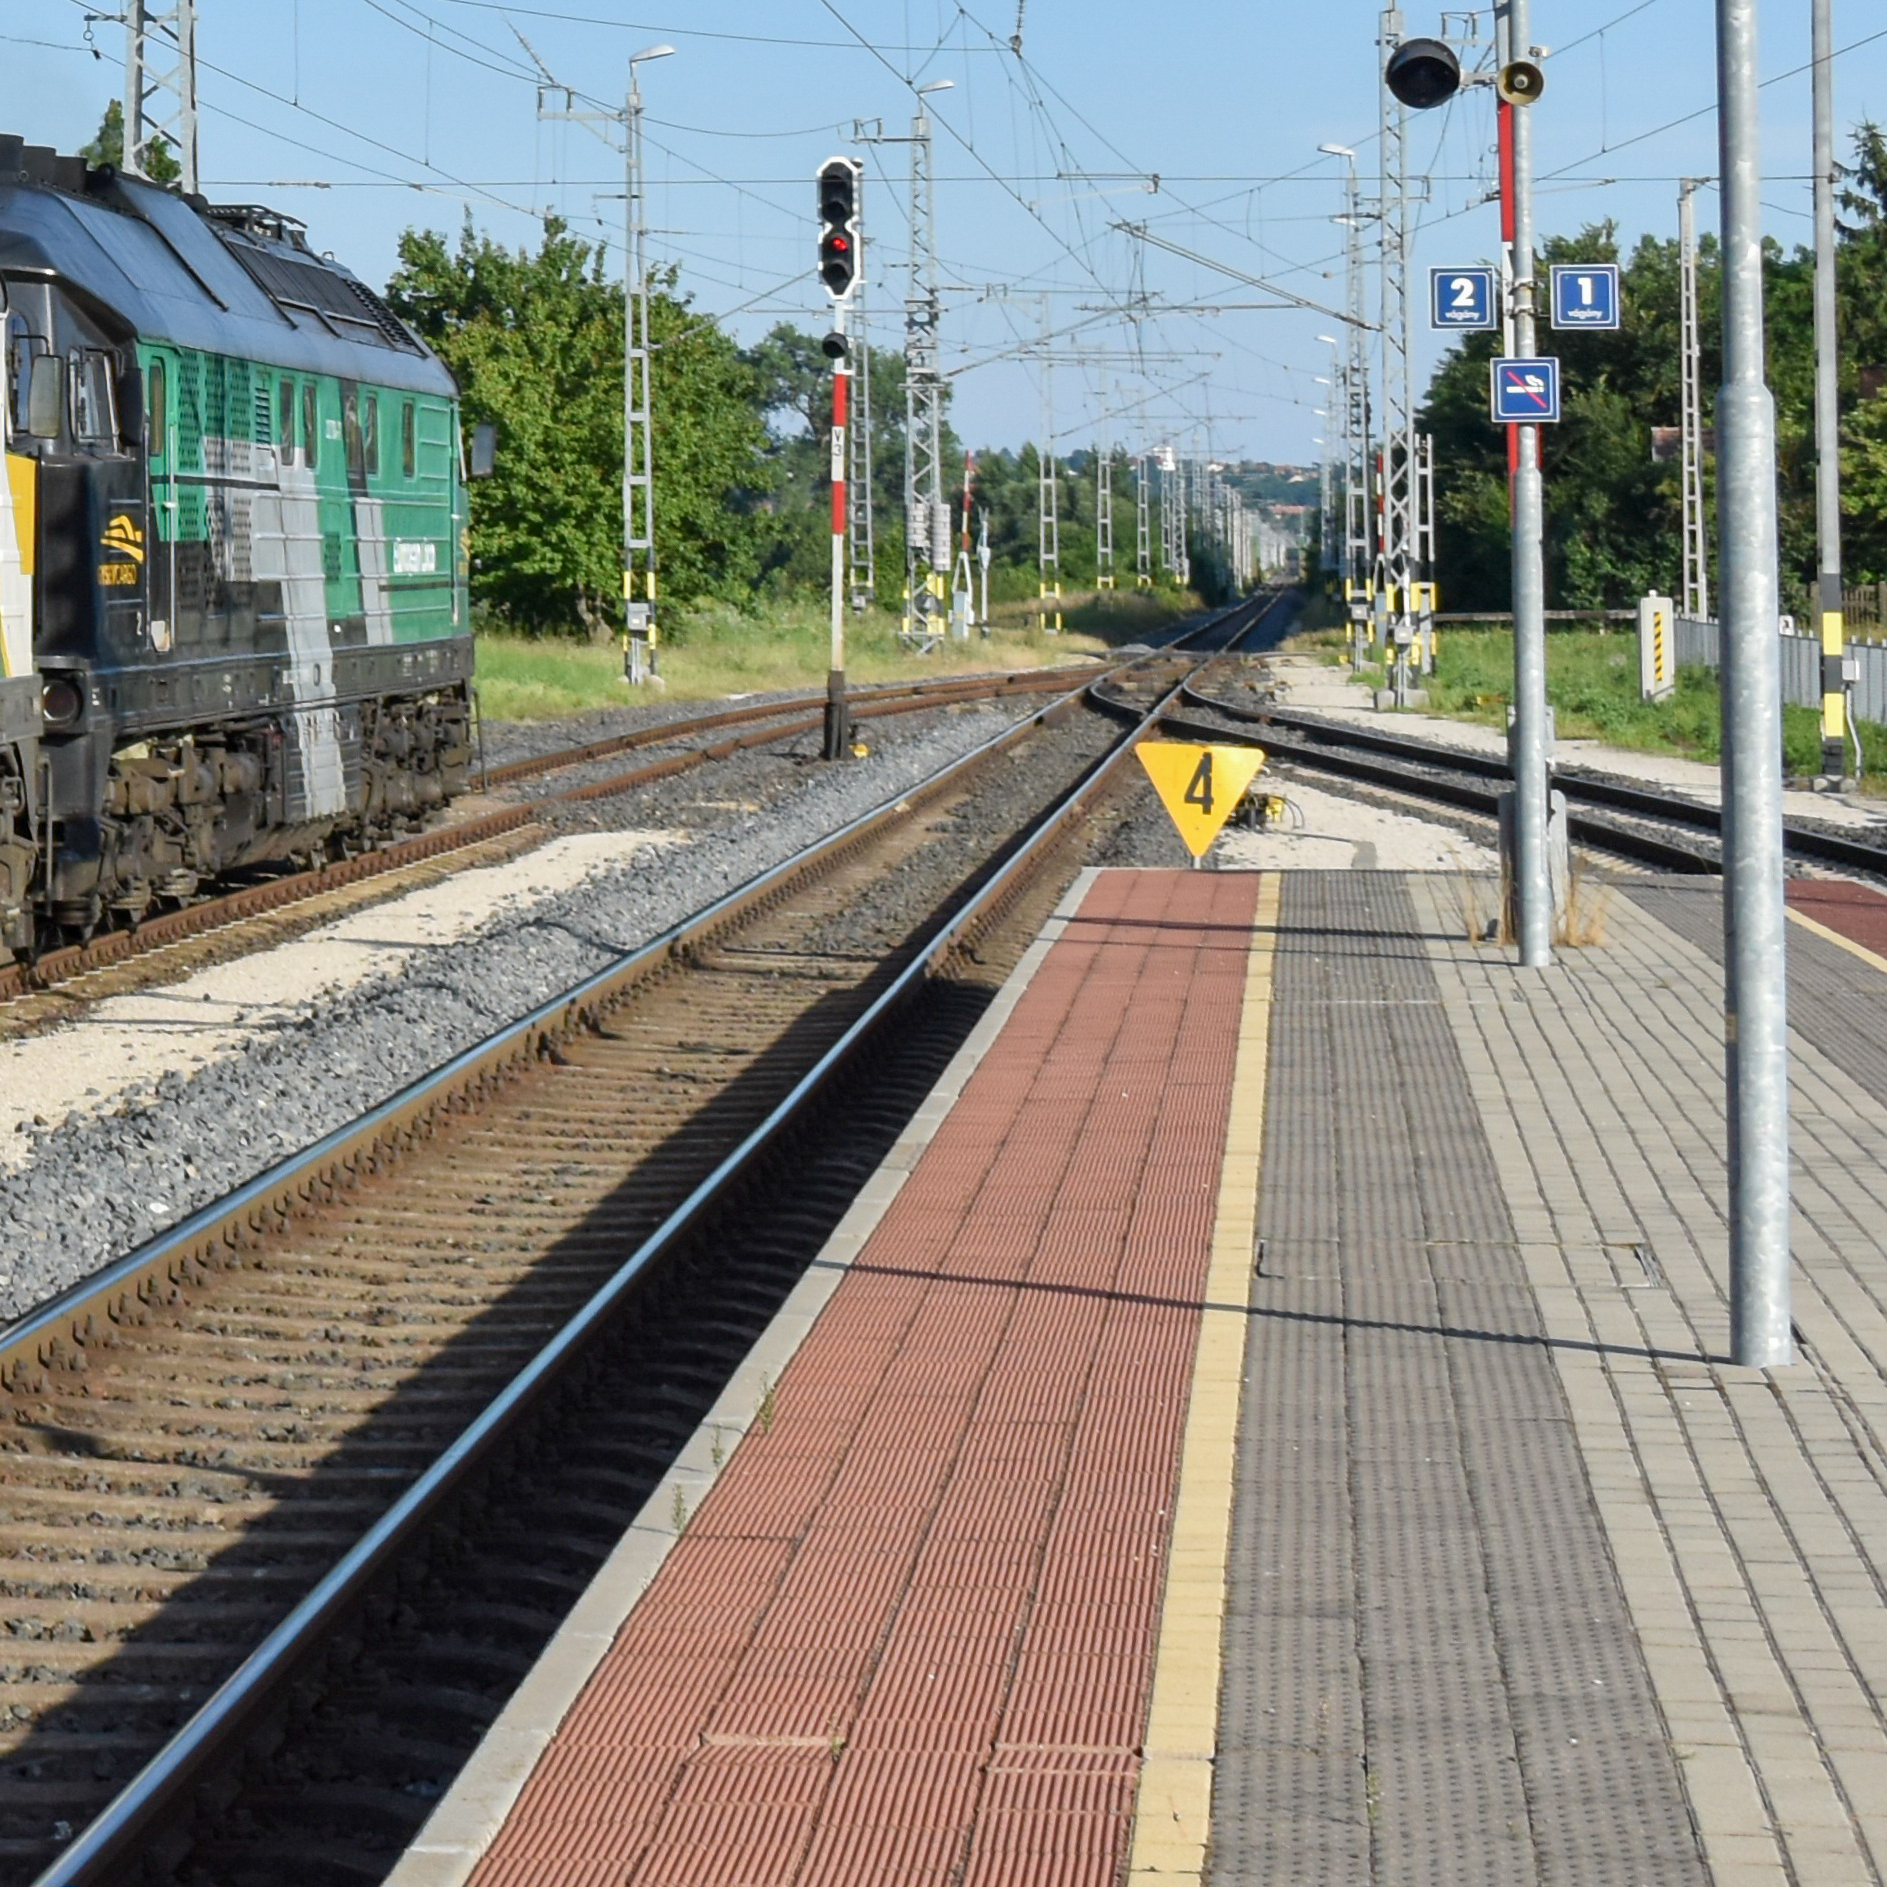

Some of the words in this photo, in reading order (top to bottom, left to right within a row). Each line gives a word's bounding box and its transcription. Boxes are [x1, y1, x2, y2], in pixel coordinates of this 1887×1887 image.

[1450, 277, 1475, 307] 2
[1577, 277, 1592, 305] 1
[1184, 752, 1214, 815] 4
